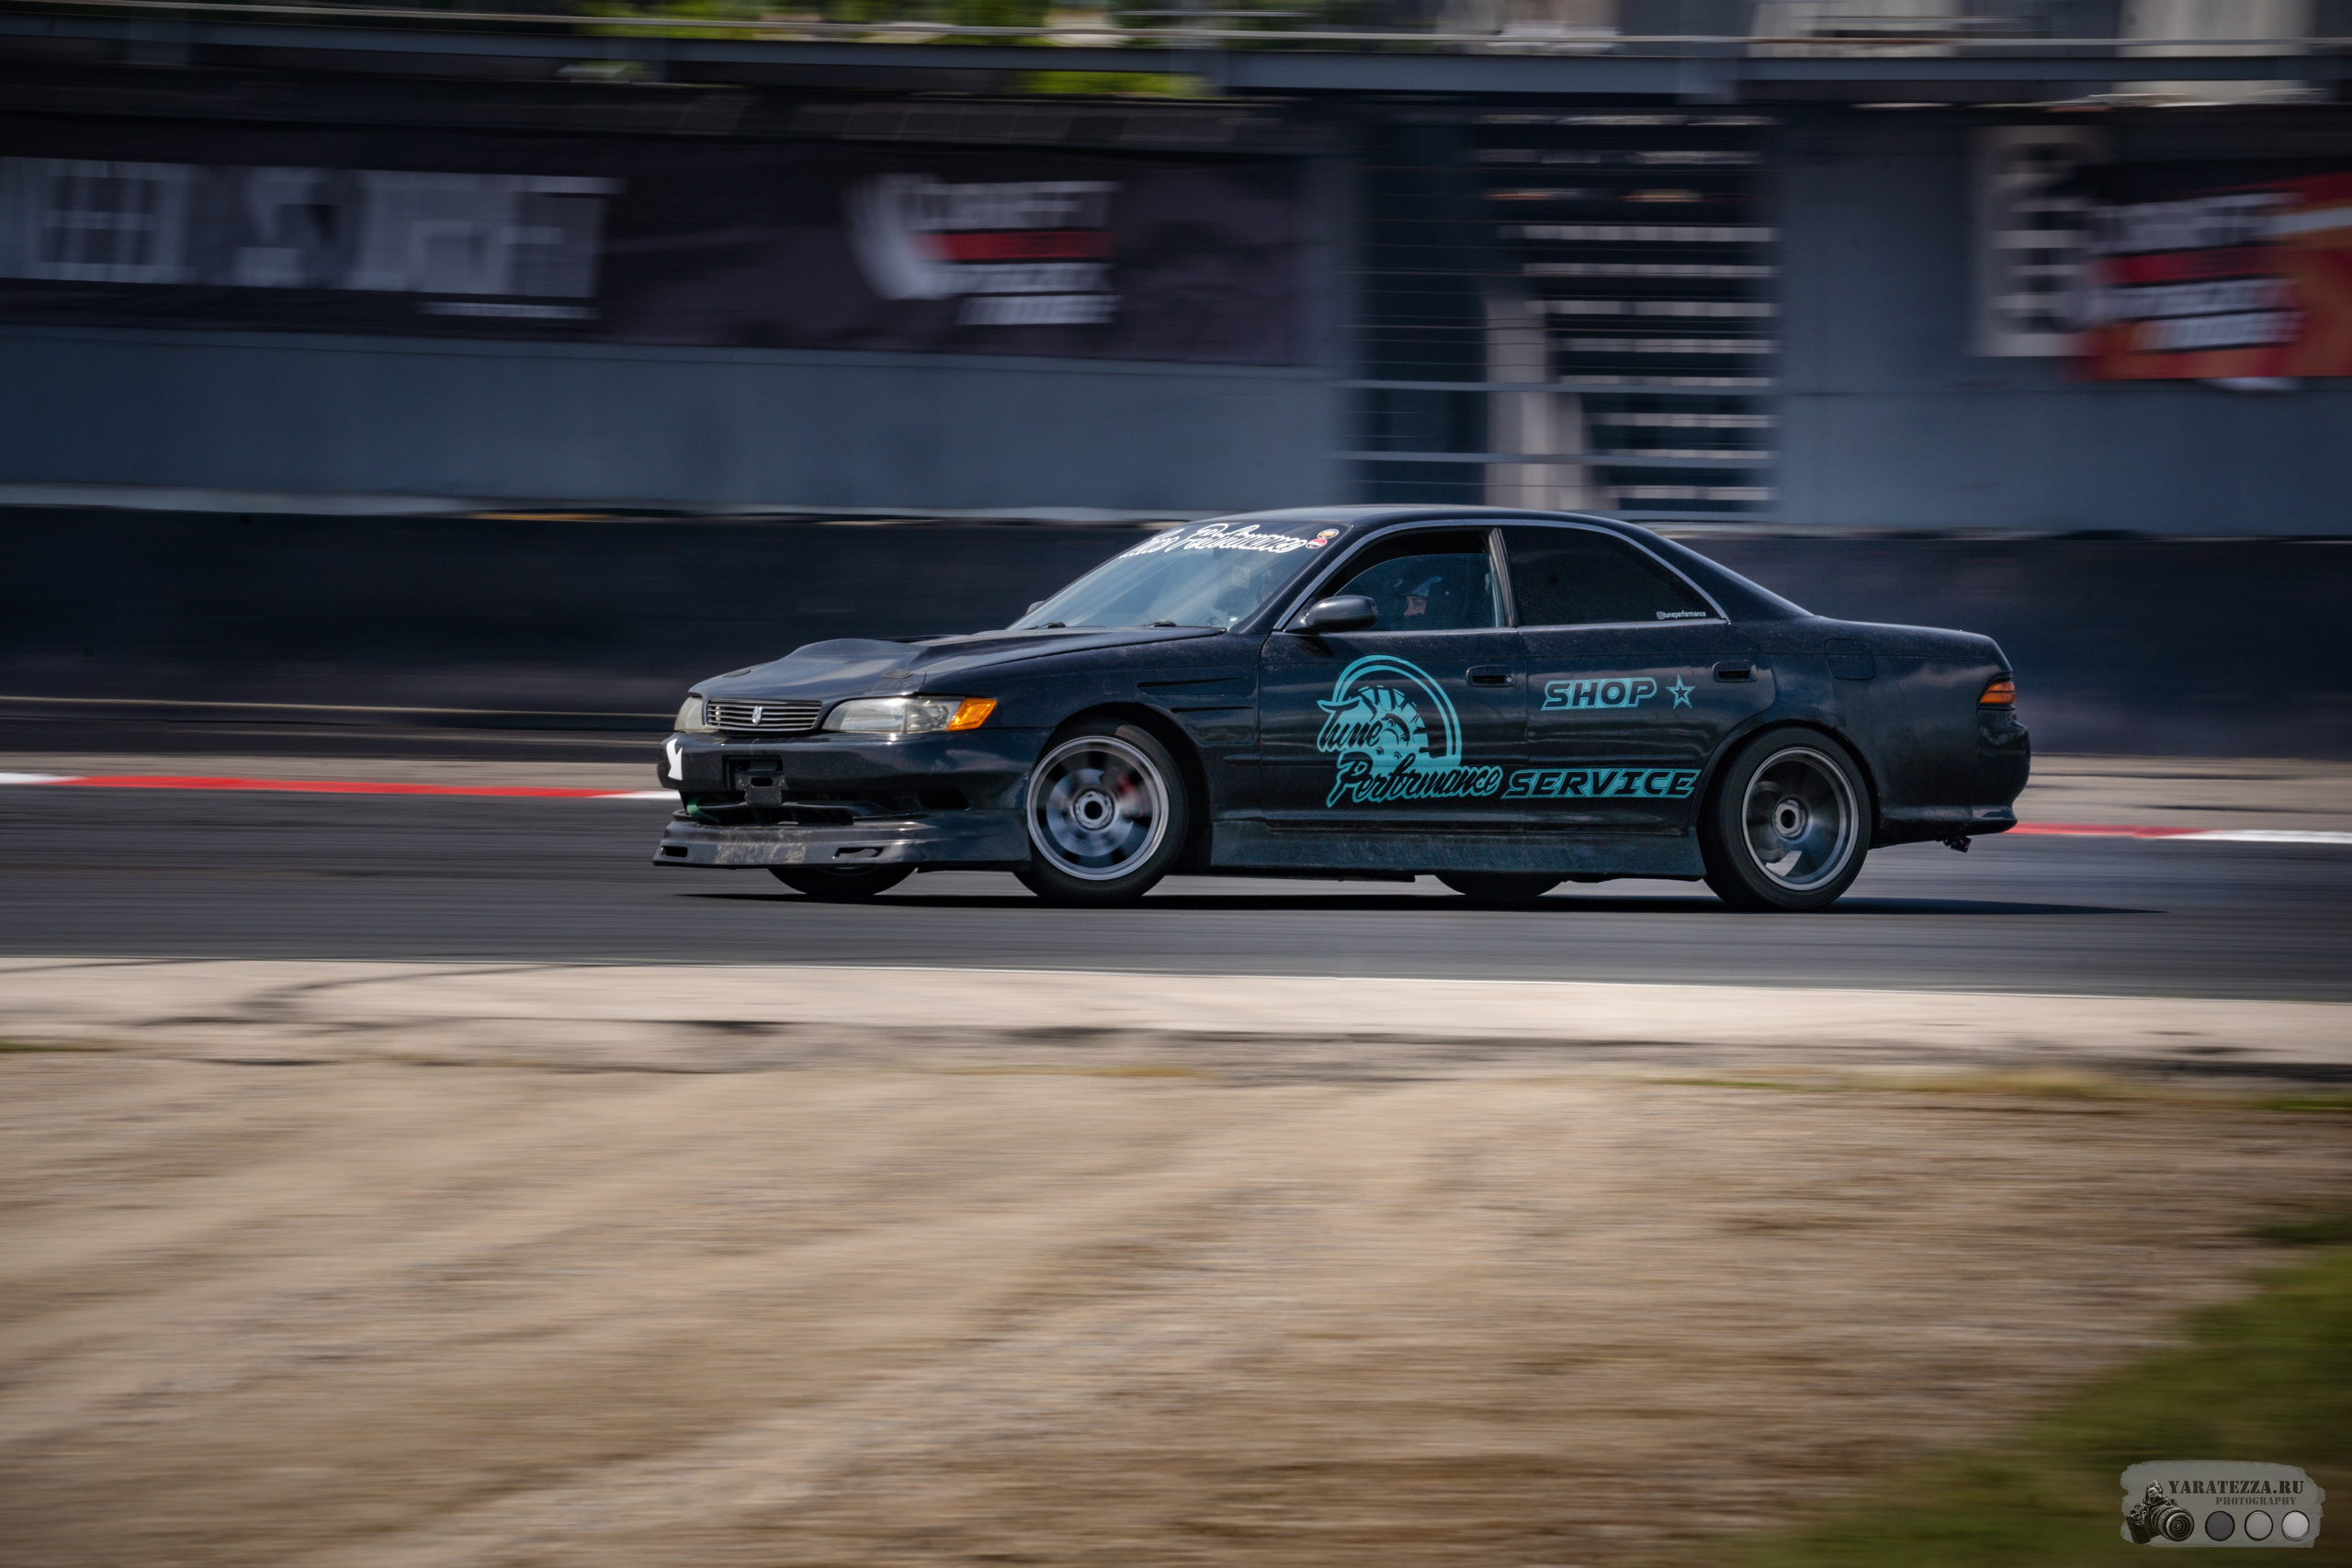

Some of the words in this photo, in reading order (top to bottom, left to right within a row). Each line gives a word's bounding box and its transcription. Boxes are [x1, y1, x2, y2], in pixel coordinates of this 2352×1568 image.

[1541, 677, 1657, 711] SHOP
[1317, 698, 1382, 752] Tune
[1326, 750, 1503, 807] Performance
[1500, 769, 1702, 799] SERVICE
